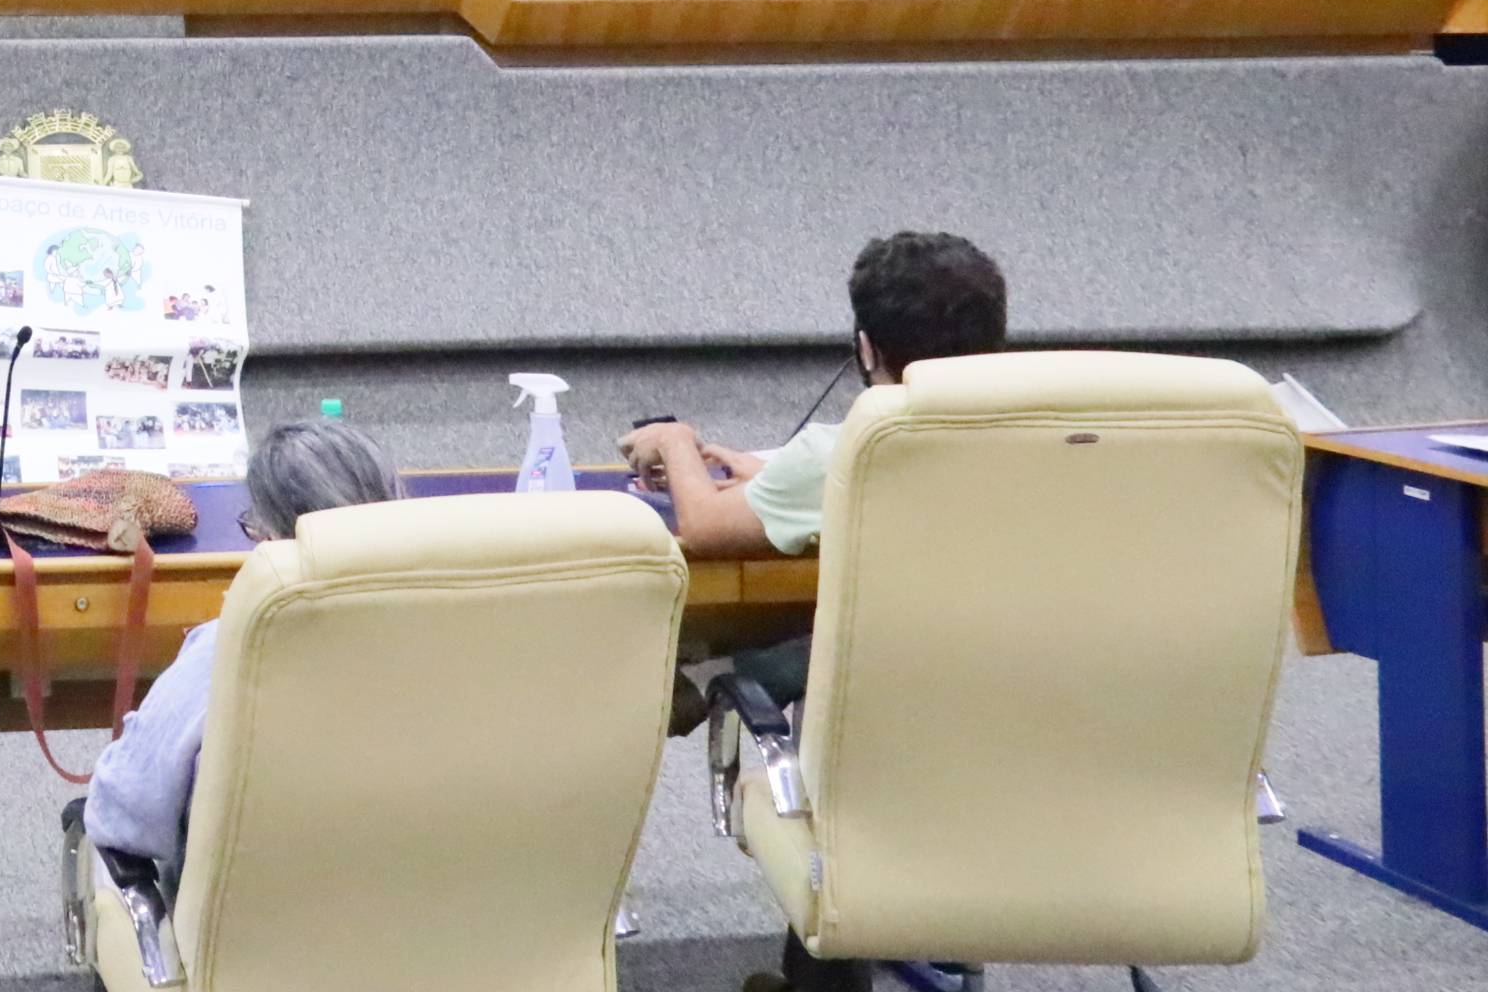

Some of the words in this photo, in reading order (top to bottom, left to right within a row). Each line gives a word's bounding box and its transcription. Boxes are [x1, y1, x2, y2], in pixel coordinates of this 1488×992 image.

[58, 201, 85, 219] de
[93, 203, 150, 225] Artes
[157, 209, 227, 232] Vitória
